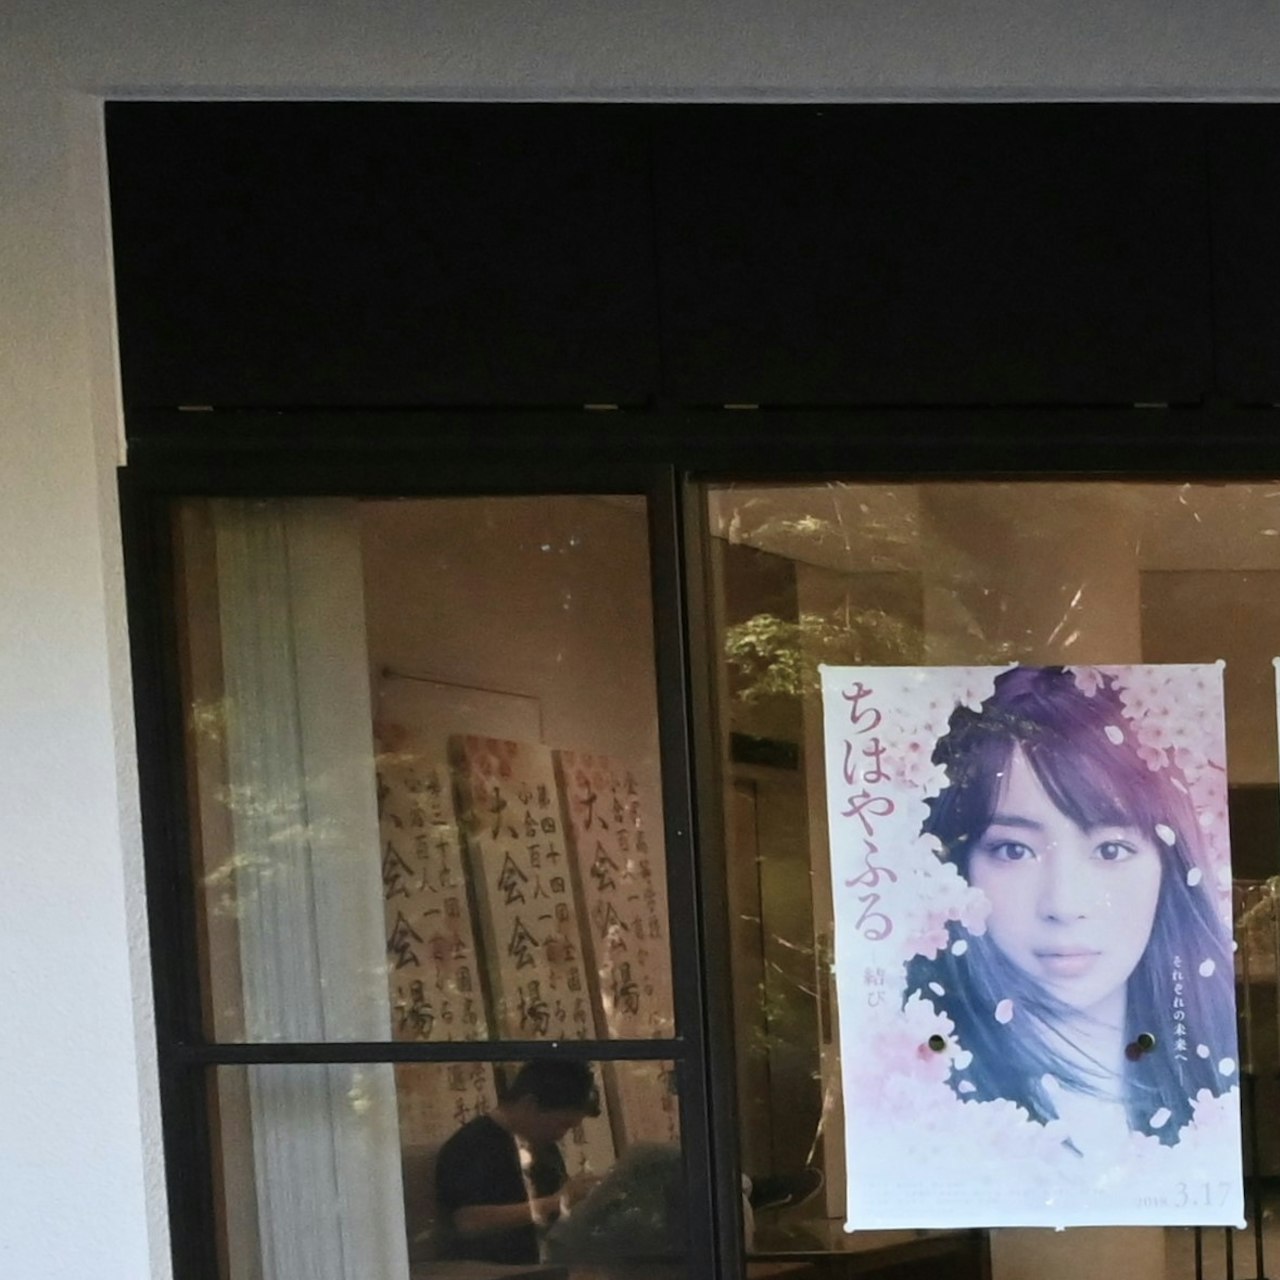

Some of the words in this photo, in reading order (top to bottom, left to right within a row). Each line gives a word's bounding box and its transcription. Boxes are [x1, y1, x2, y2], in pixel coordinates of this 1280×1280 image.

[840, 681, 899, 943] ちはやふる
[1174, 1181, 1233, 1208] 3.17
